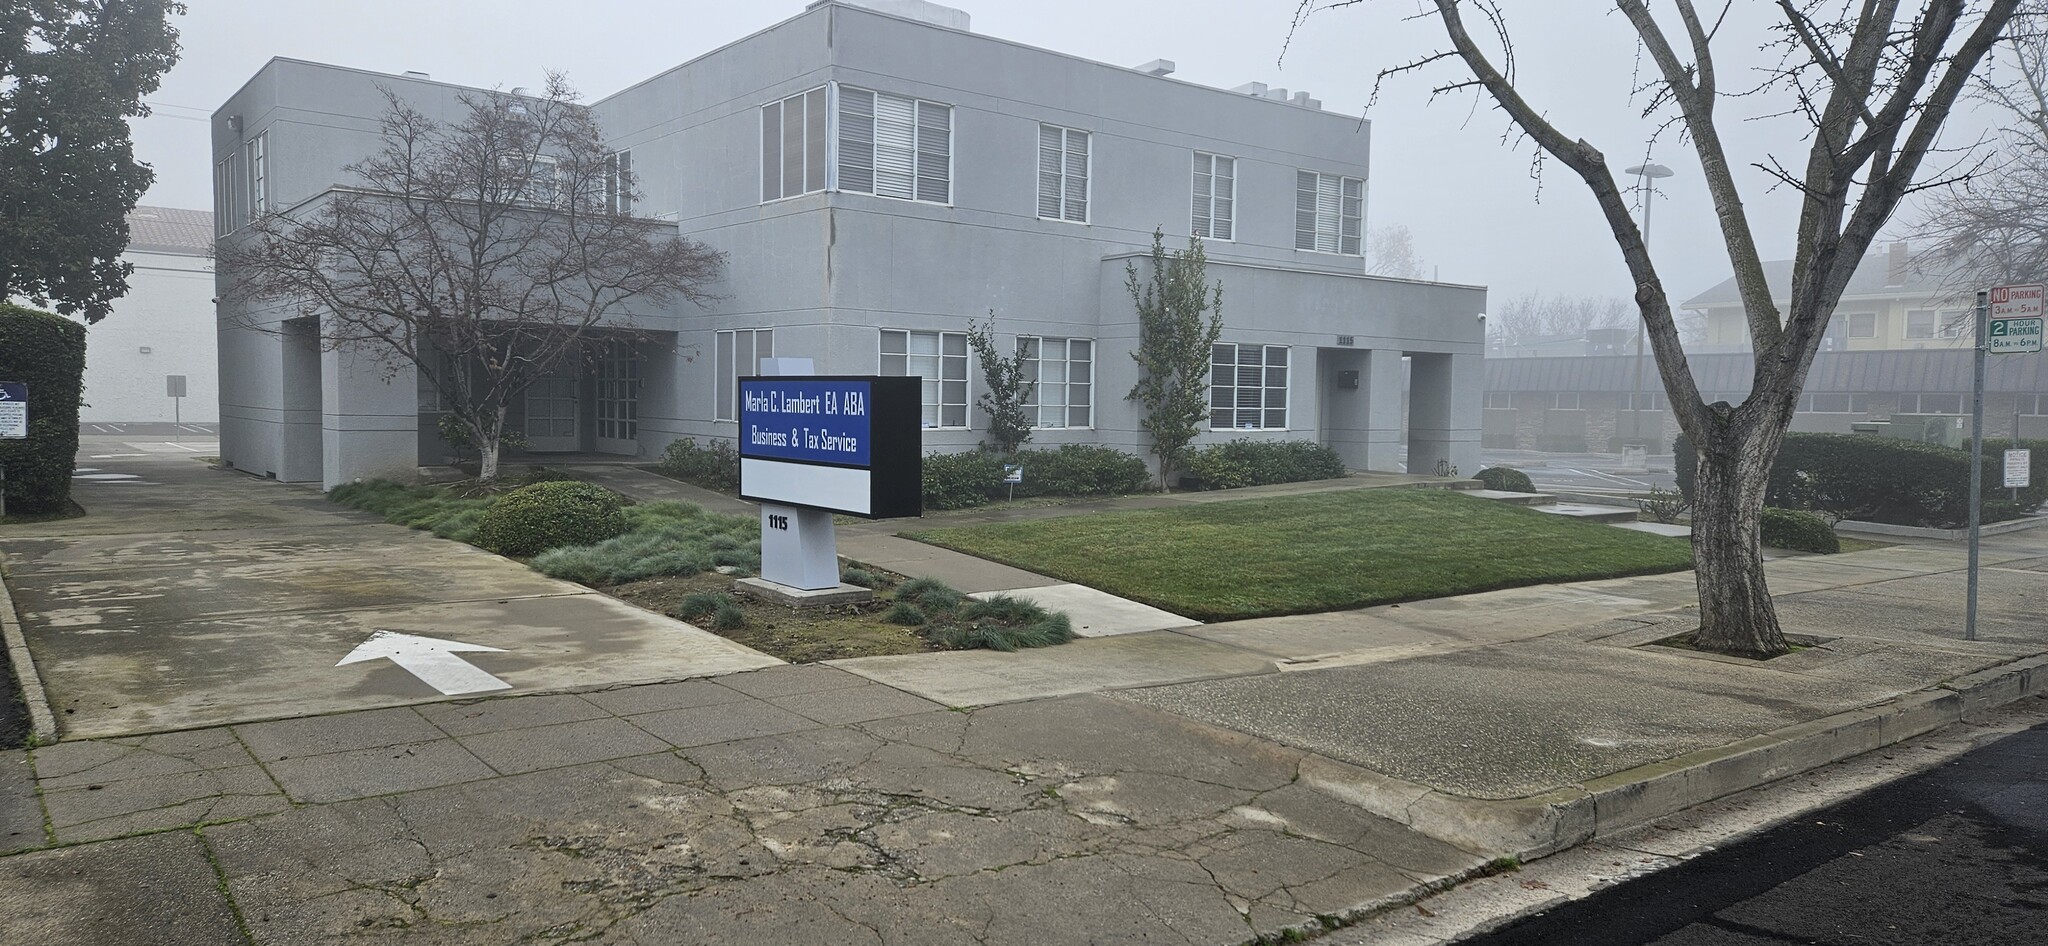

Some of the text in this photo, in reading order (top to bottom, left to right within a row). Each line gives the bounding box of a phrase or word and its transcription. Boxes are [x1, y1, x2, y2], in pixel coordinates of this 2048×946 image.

[1993, 288, 2041, 302] NO PARKING
[1993, 321, 2004, 335] 2
[2009, 326, 2039, 336] PARKING
[1339, 336, 1354, 345] 1115
[745, 390, 865, 416] Marla C. Lambert EA ABA
[751, 425, 857, 453] Business & Tax Service
[768, 514, 788, 531] 1115
